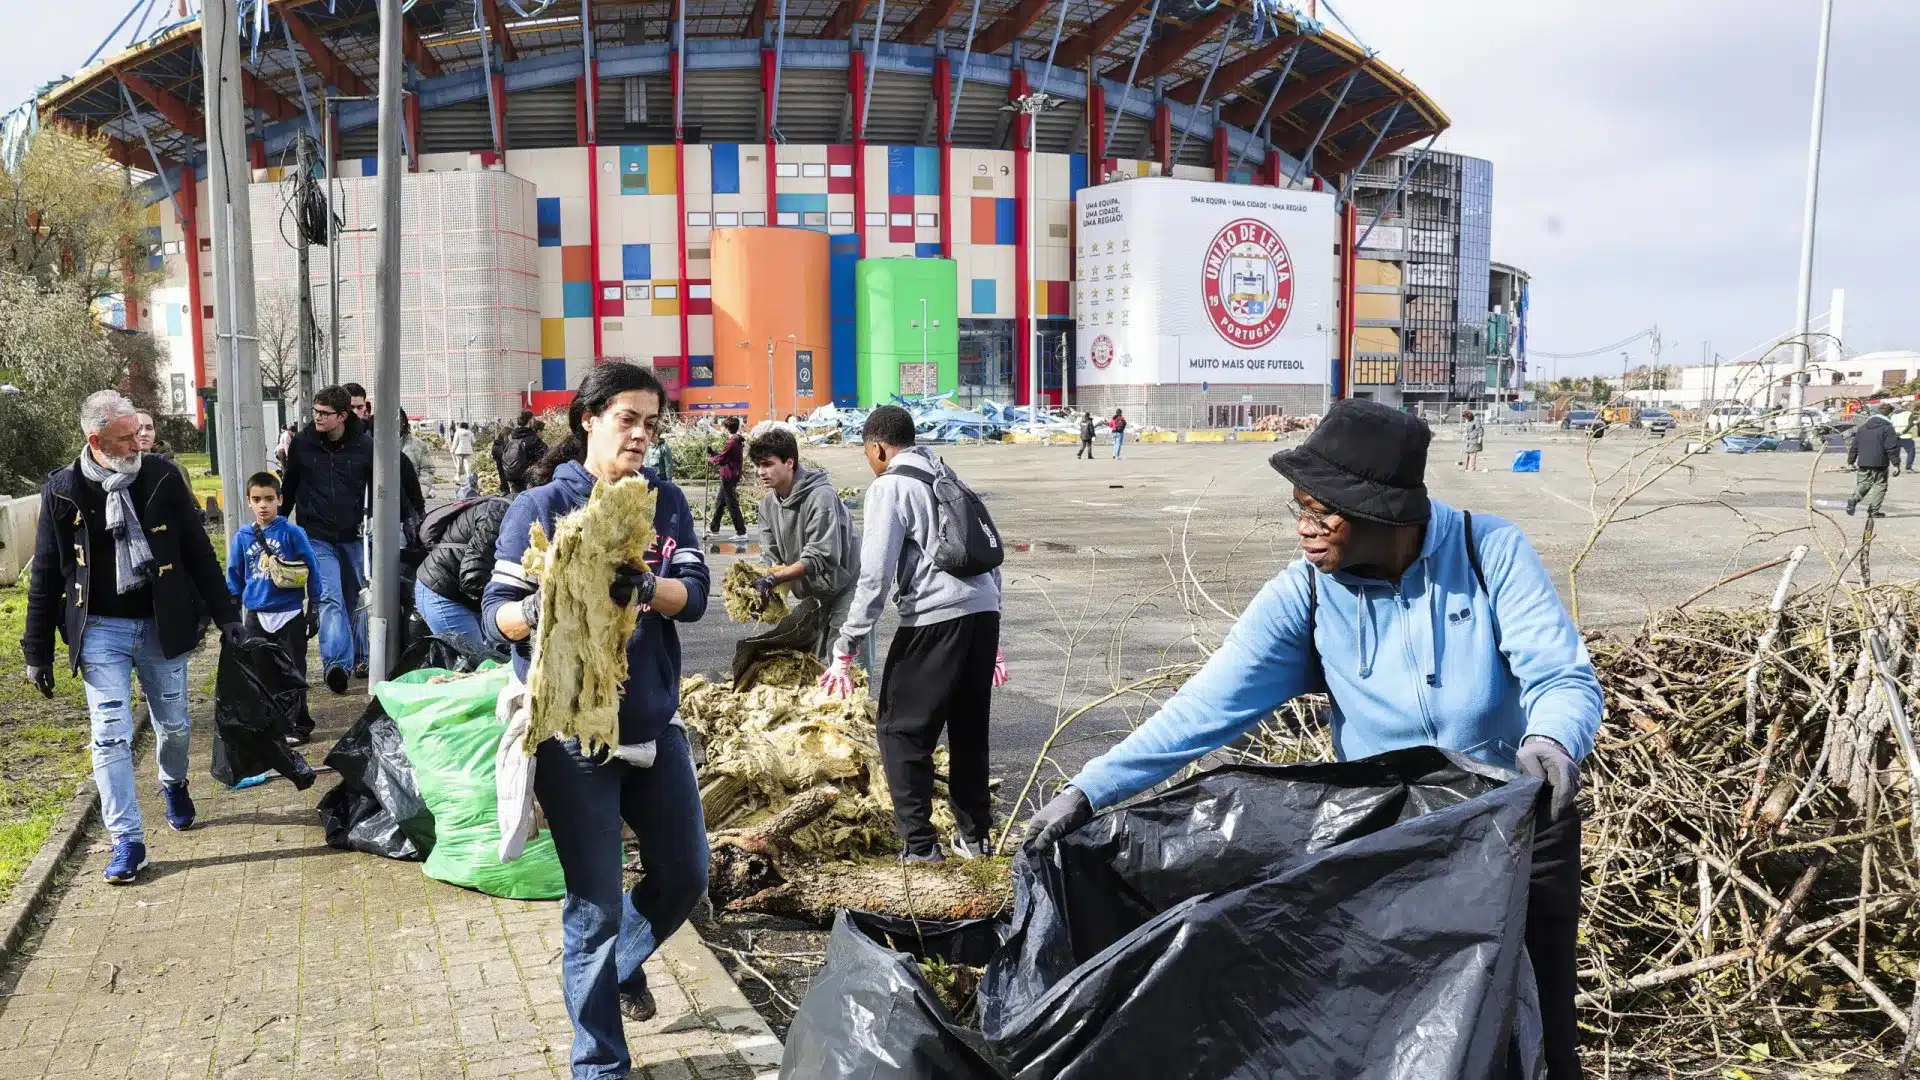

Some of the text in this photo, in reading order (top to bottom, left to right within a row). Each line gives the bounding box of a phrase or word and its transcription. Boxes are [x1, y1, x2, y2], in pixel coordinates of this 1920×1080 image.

[1086, 198, 1121, 210] UMA EQUIPA,
[1191, 195, 1308, 212] UMA EQUIPA UMA CIDADE UMA REGIÃO
[1099, 207, 1121, 216] CIDADE,
[1083, 219, 1097, 227] UMA
[1206, 224, 1290, 283] UNIÃO DE LEIRIA
[1208, 295, 1288, 310] 19 66
[1220, 316, 1276, 341] PORTUGAL
[1189, 358, 1305, 370] MUITO MAIS QUE FUTEBOL
